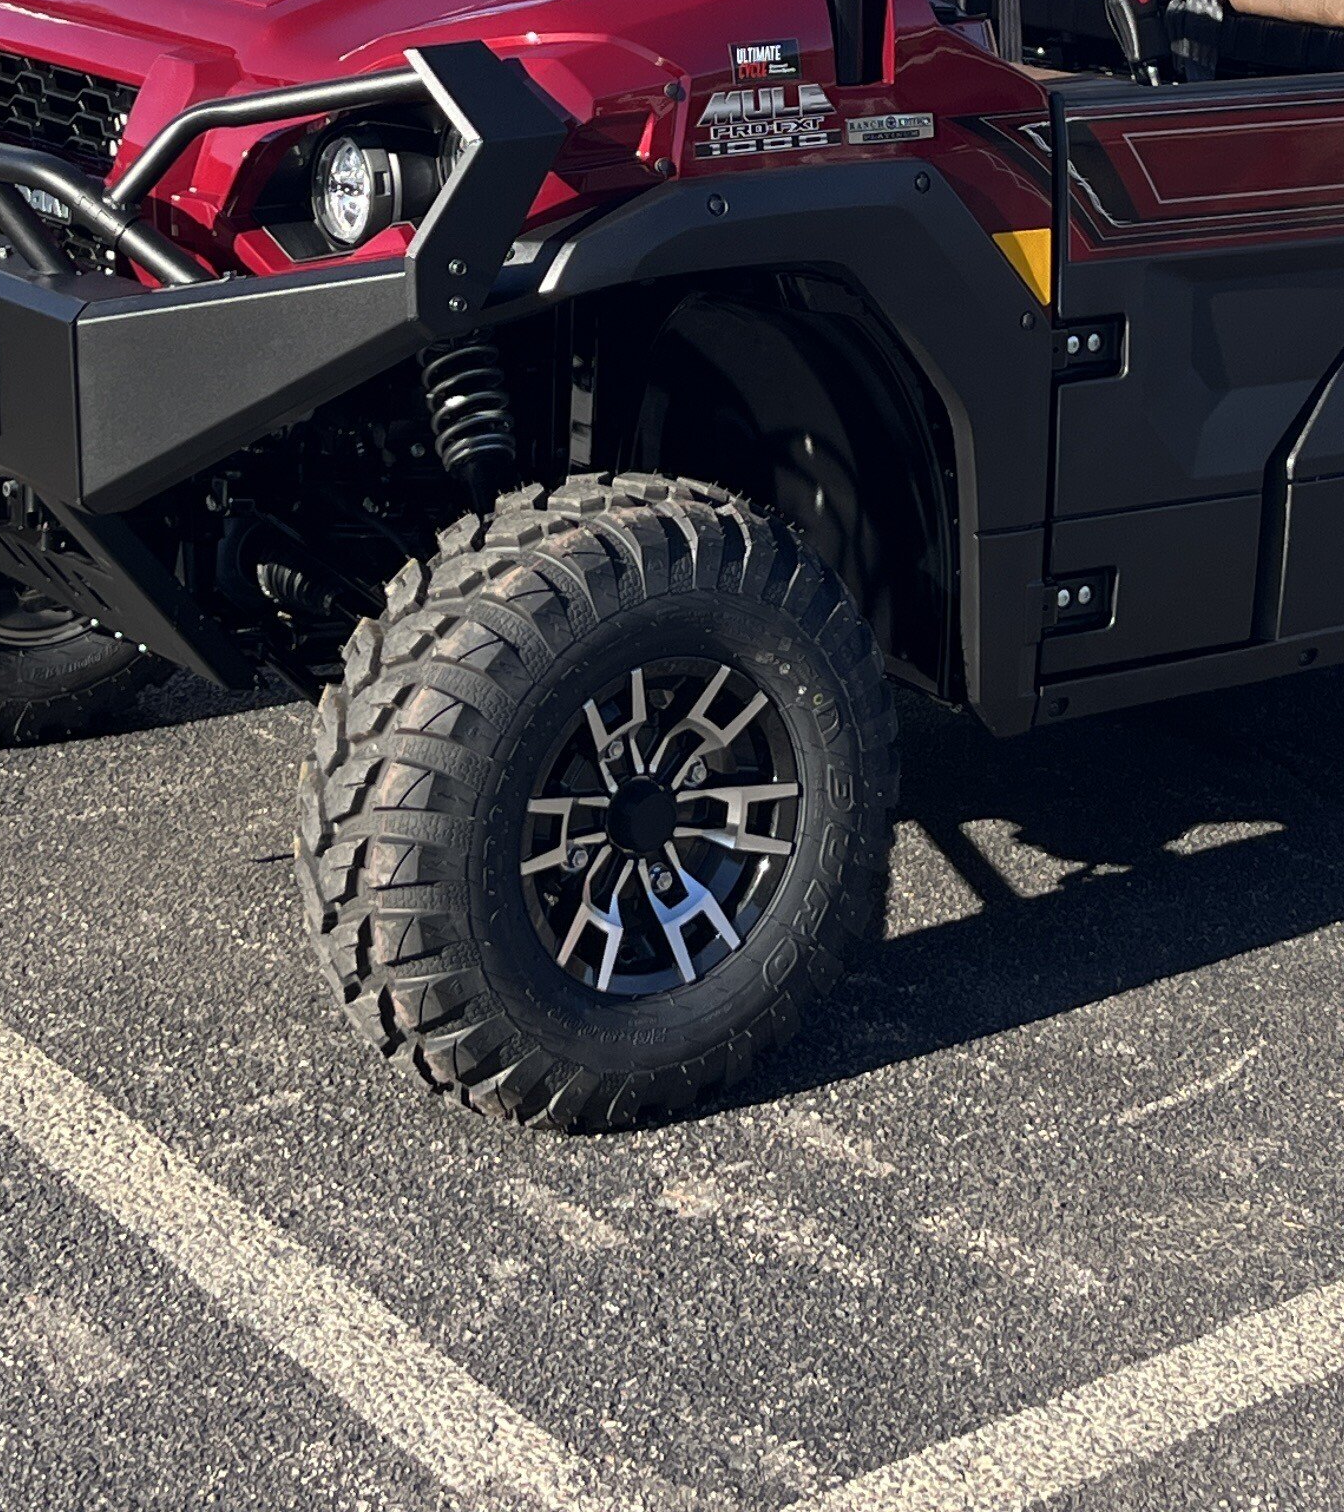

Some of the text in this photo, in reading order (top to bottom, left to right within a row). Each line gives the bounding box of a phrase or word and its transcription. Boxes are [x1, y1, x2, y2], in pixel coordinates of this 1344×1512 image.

[736, 45, 781, 64] ULTIMATE
[738, 61, 768, 79] CYCLE
[697, 83, 837, 127] MULE
[709, 133, 829, 156] 1000
